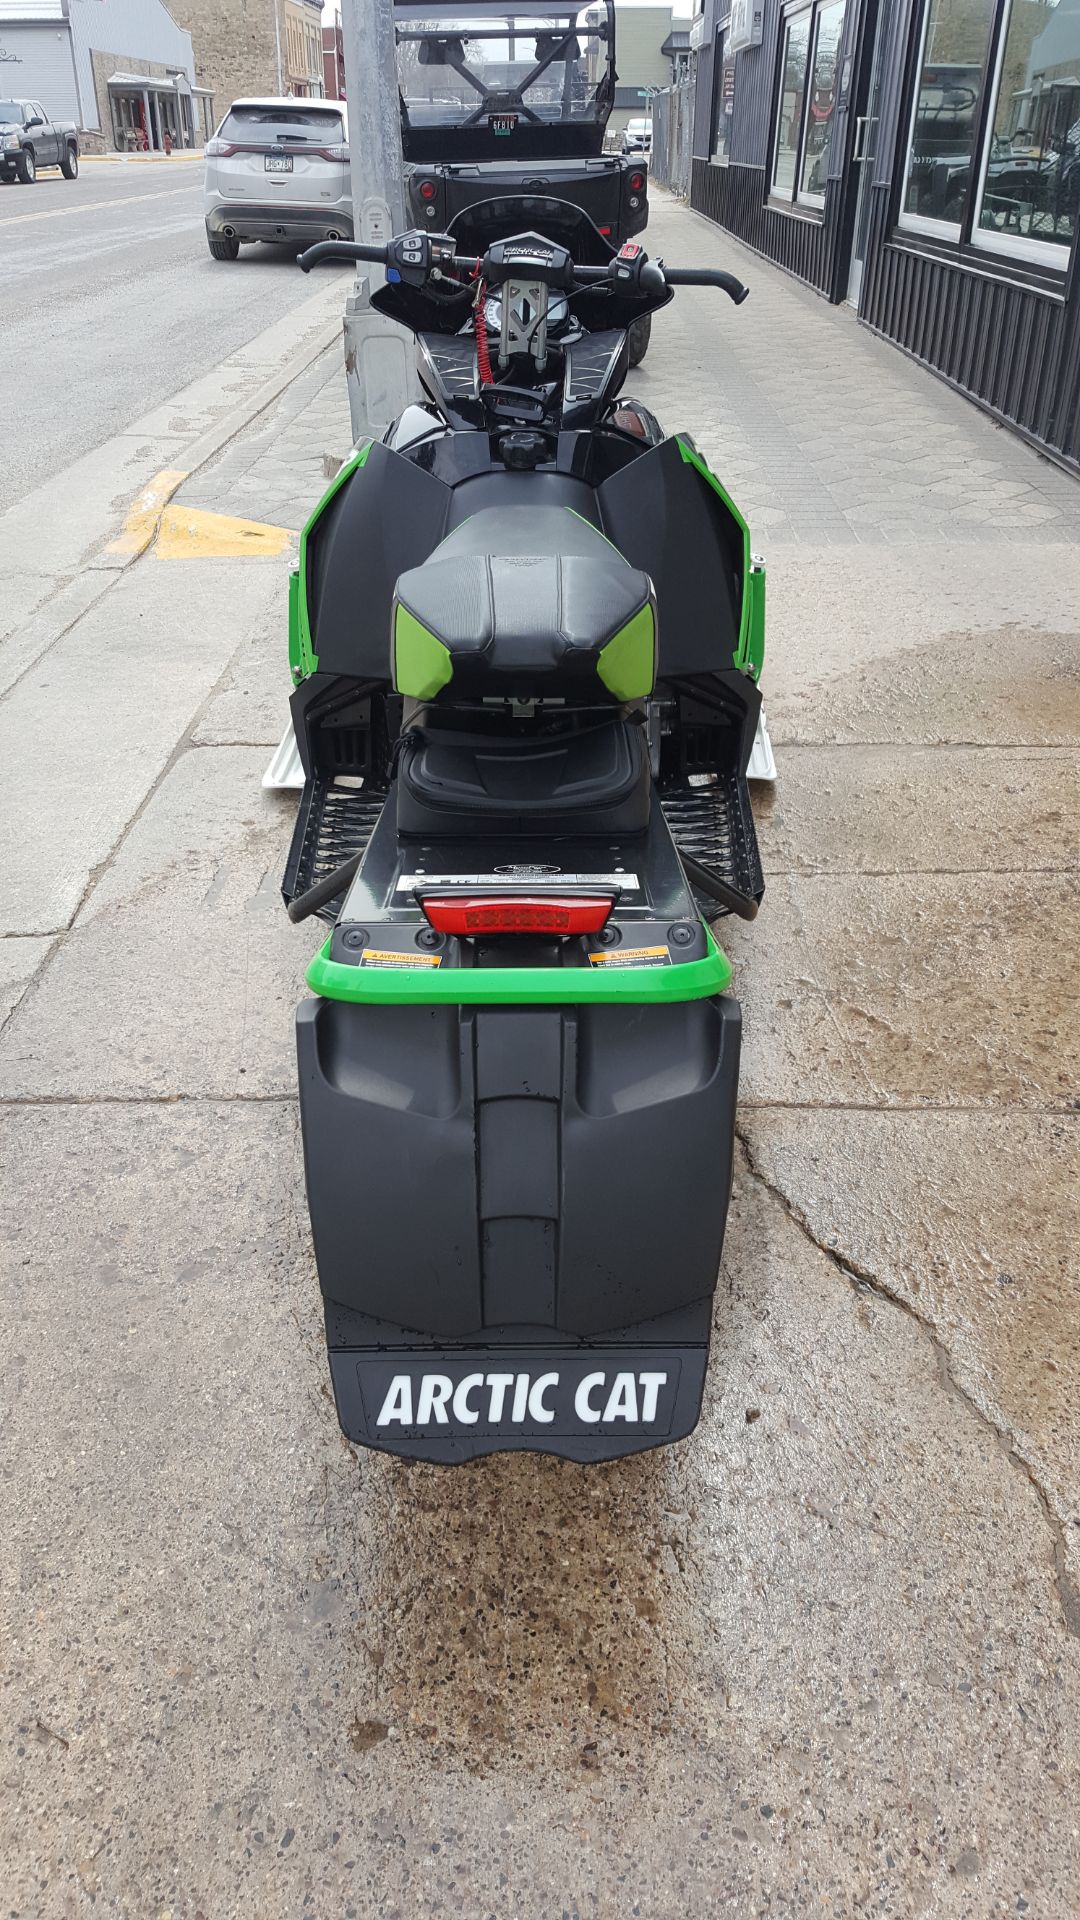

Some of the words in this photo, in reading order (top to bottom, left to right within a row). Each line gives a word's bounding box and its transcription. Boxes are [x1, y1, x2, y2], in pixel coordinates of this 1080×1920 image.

[379, 953, 432, 962] AVERTISSEMENT
[617, 950, 649, 958] WARNING
[375, 1371, 560, 1427] ARCTIC
[573, 1371, 668, 1424] CAT
